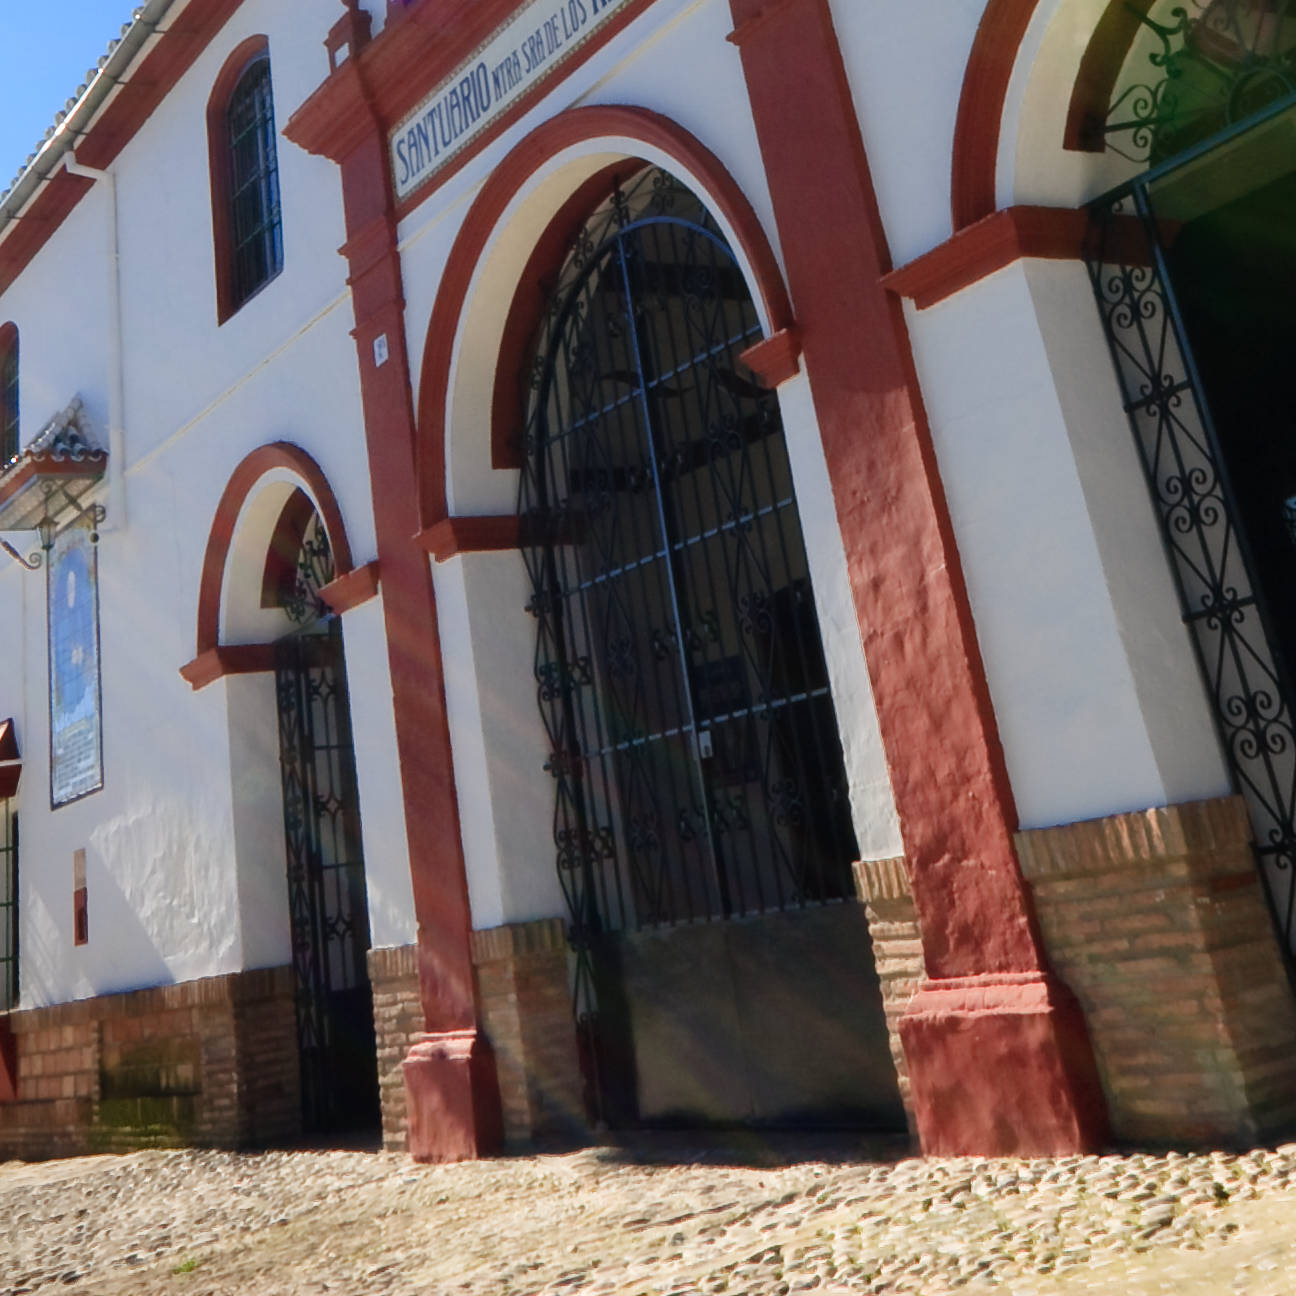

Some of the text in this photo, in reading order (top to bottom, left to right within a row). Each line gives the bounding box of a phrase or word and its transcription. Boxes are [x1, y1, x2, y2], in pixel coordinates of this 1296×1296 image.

[397, 62, 491, 185] SANTUARIO
[492, 49, 522, 102] NTRA
[521, 27, 546, 74] SRA
[543, 13, 563, 56] DE
